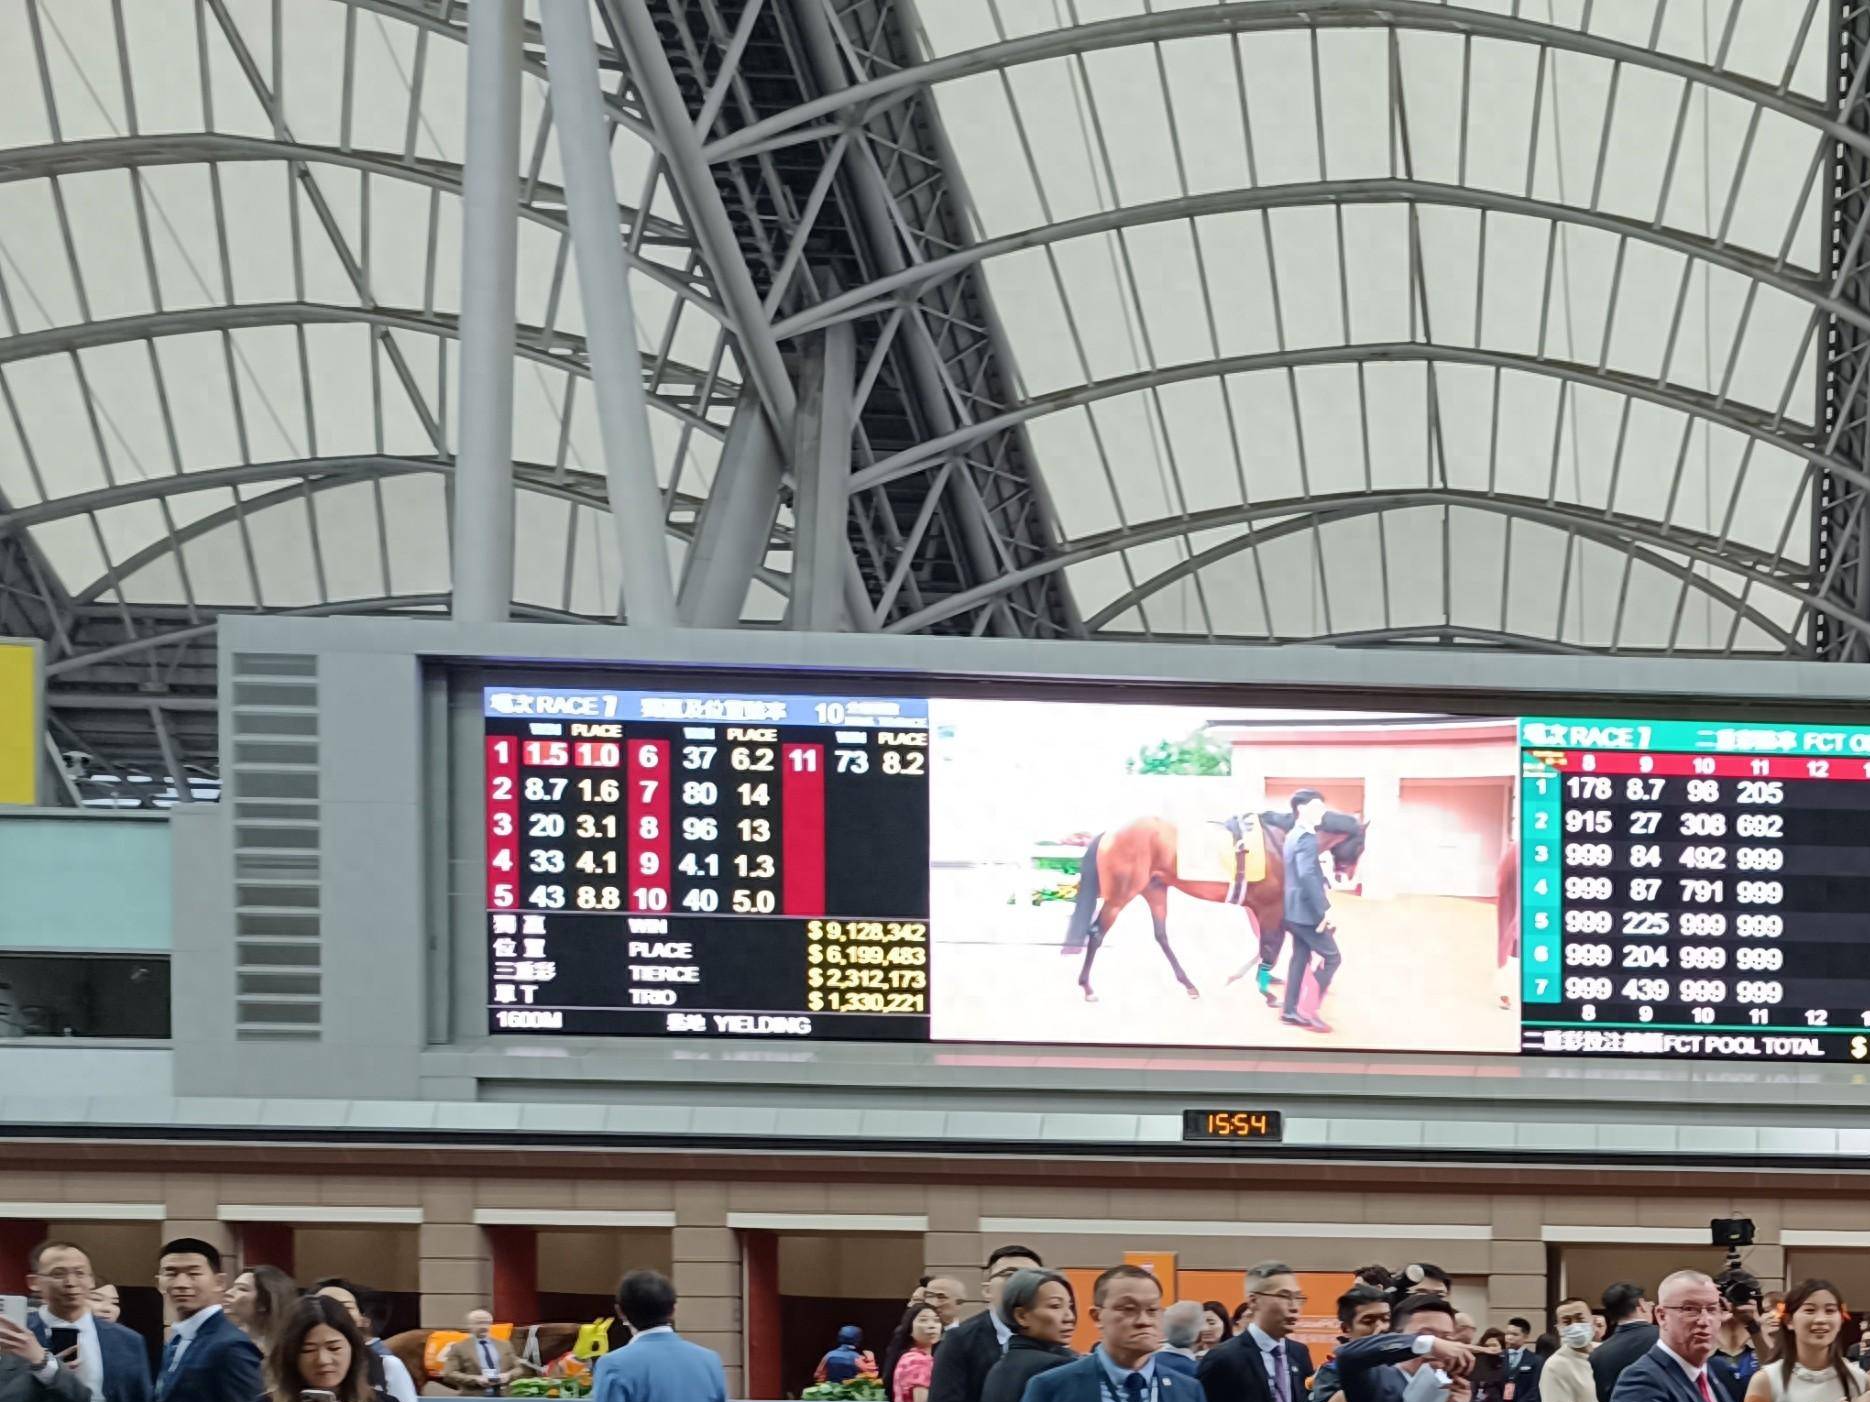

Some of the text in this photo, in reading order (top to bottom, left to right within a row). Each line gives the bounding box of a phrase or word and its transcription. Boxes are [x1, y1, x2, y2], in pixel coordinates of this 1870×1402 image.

[536, 694, 599, 716] RACE
[815, 702, 845, 725] 10
[571, 724, 622, 737] PLACE
[727, 728, 777, 741] PLACE
[878, 732, 928, 746] PLACE
[1570, 726, 1634, 748] RACE
[1803, 732, 1846, 752] FCT
[495, 741, 924, 774] 1 1.5 1.0 6 37 6.2 11 73 8.2
[1583, 754, 1595, 771] 8
[1640, 756, 1653, 772] 9
[1693, 758, 1715, 774] 10
[1751, 759, 1769, 775] 11
[1807, 761, 1829, 777] 12
[493, 777, 770, 805] 2 8.7 1.6 7 80 14
[1535, 778, 1547, 795] 1
[1567, 777, 1612, 799] 178
[1627, 778, 1665, 800] 8.7
[1687, 780, 1719, 802] 98
[1737, 781, 1783, 804] 205
[494, 813, 770, 842] 3 20 3.1 8 96 13
[1536, 813, 1547, 828] 2
[1566, 810, 1612, 833] 915
[1630, 812, 1661, 834] 27
[1680, 813, 1726, 836] 308
[1737, 815, 1783, 837] 692
[493, 849, 774, 877] 4 33 4.1 9 4.1 1.3
[1536, 846, 1548, 861] 3
[1565, 843, 1612, 866] 999
[1630, 845, 1661, 867] 84
[1679, 847, 1726, 869] 492
[1737, 848, 1783, 870] 999
[494, 884, 775, 913] 5 43 8.8 10 40 5.0
[1535, 880, 1547, 894] 4
[1565, 877, 1612, 899] 999
[1630, 879, 1661, 901] 87
[1680, 880, 1723, 902] 791
[1737, 881, 1783, 904] 999
[1536, 913, 1548, 928] 5
[1565, 911, 1612, 933] 999
[1623, 912, 1669, 934] 225
[1680, 913, 1726, 936] 999
[1737, 915, 1783, 937] 999
[629, 942, 692, 958] PLACE
[1535, 946, 1548, 961] 6
[1566, 944, 1612, 966] 999
[1623, 945, 1669, 967] 204
[1680, 946, 1726, 969] 999
[1737, 948, 1783, 970] 999
[629, 965, 699, 982] TIERCE
[1537, 980, 1547, 994] 7
[1565, 977, 1612, 1000] 999
[1622, 979, 1669, 1001] 439
[1680, 980, 1726, 1002] 999
[1737, 981, 1783, 1003] 999
[713, 1015, 811, 1034] YIELDING
[1582, 1004, 1596, 1020] 8
[1639, 1006, 1653, 1021] 9
[1692, 1007, 1715, 1023] 10
[1749, 1009, 1768, 1024] 11
[1805, 1010, 1827, 1025] 12
[1664, 1035, 1703, 1053] FCT
[1705, 1036, 1761, 1055] POOL
[1762, 1037, 1825, 1056] TOTAL
[1208, 1113, 1267, 1135] 15:54
